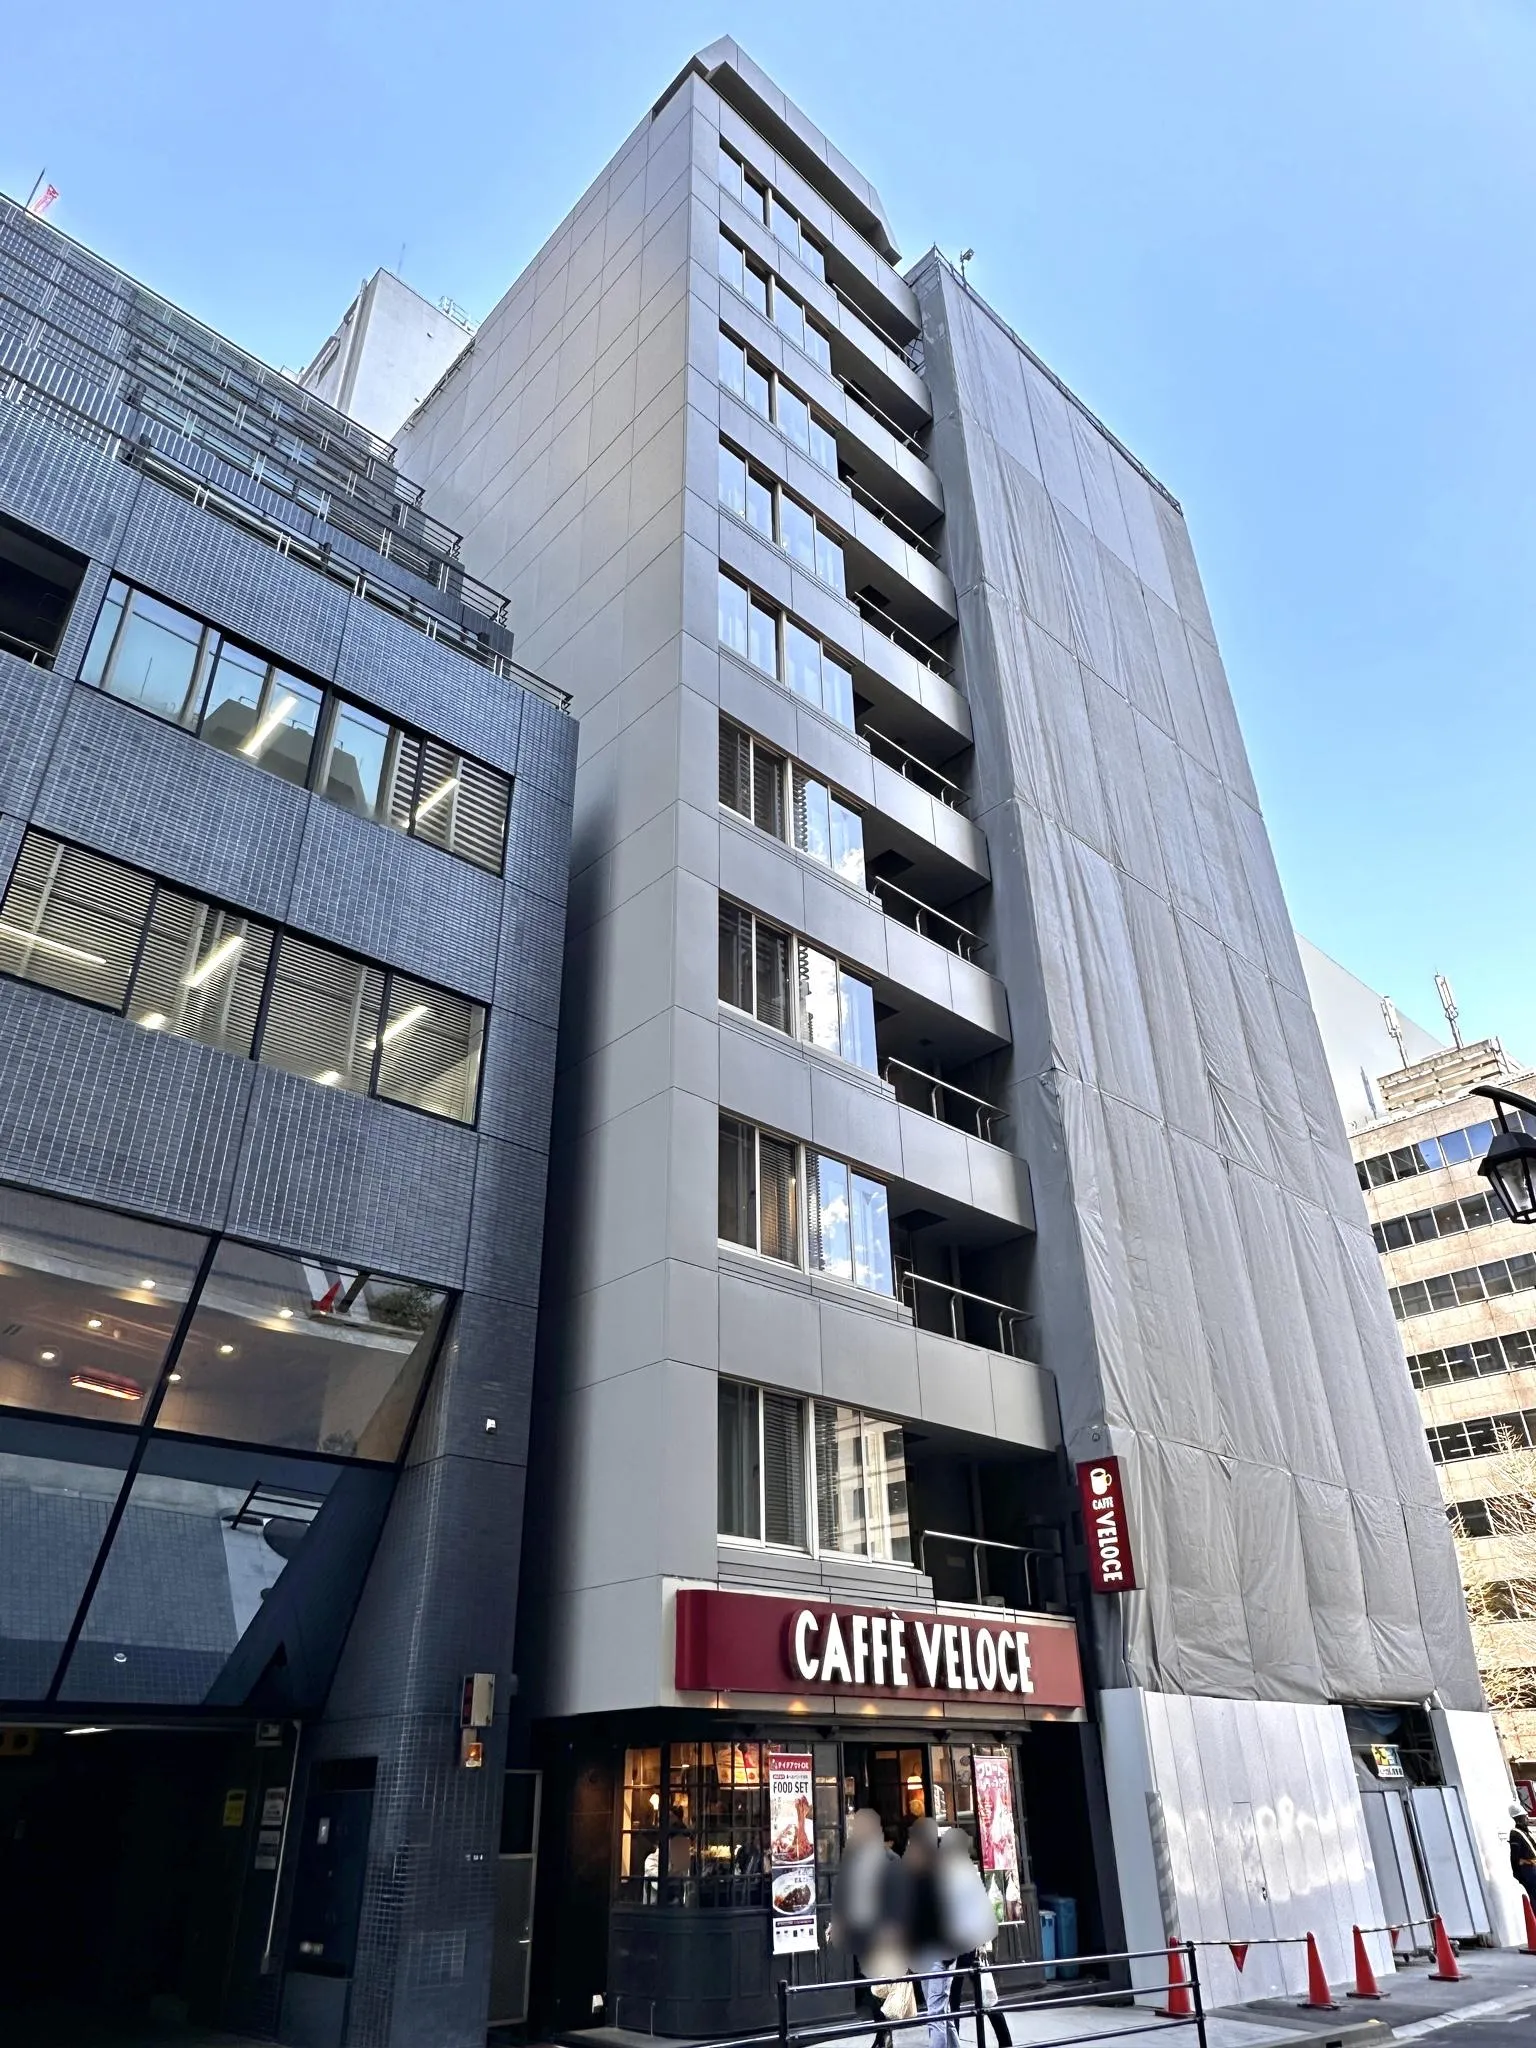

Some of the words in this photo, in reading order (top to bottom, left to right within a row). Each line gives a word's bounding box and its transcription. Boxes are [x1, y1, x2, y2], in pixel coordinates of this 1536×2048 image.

[1096, 1510, 1124, 1583] VELOCE
[794, 1609, 909, 1687] CAFFÈ
[914, 1620, 1035, 1693] VELOCE
[773, 1781, 793, 1794] FOOD
[795, 1781, 809, 1794] SET
